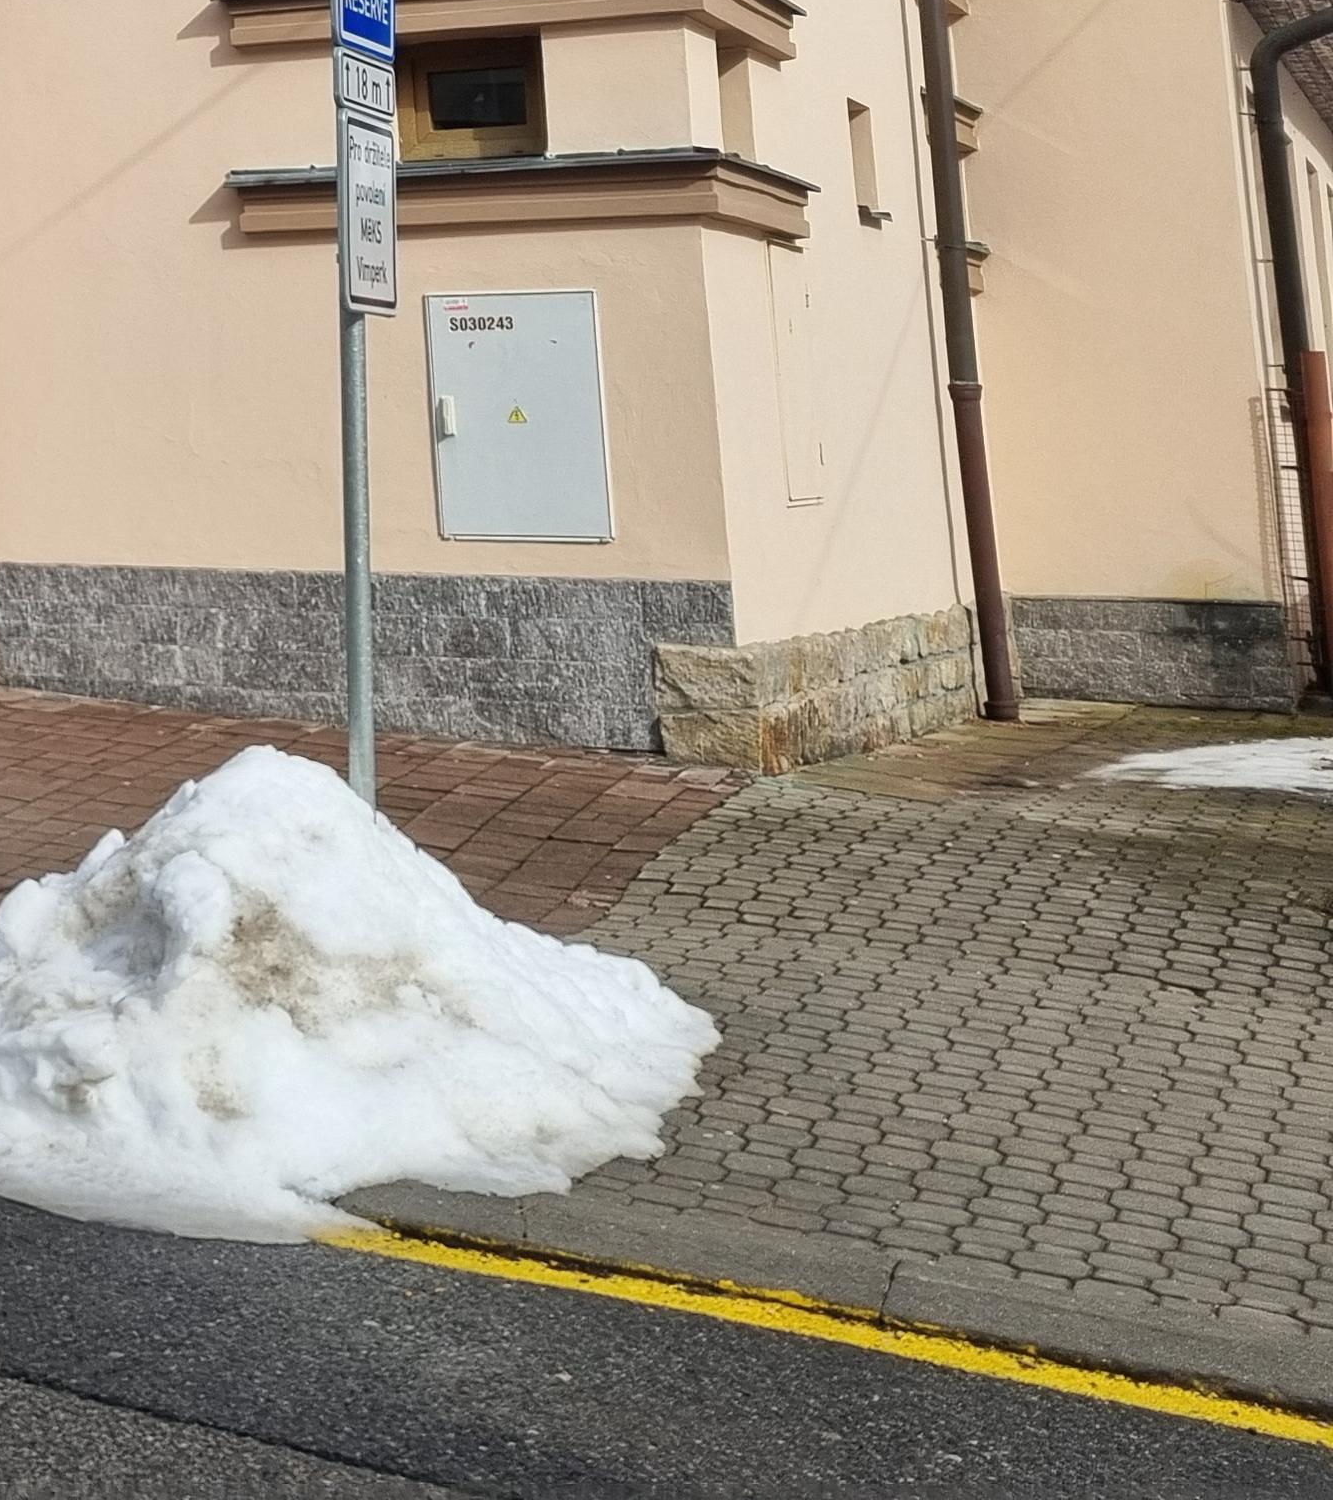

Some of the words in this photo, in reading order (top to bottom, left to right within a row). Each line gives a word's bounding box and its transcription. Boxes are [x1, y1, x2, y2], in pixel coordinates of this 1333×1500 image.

[356, 66, 368, 104] 18
[371, 80, 382, 106] m
[349, 135, 362, 163] Pro
[364, 140, 391, 169] držitele
[355, 182, 386, 208] povolení
[356, 255, 389, 289] Vimperk
[449, 316, 514, 332] S030243
